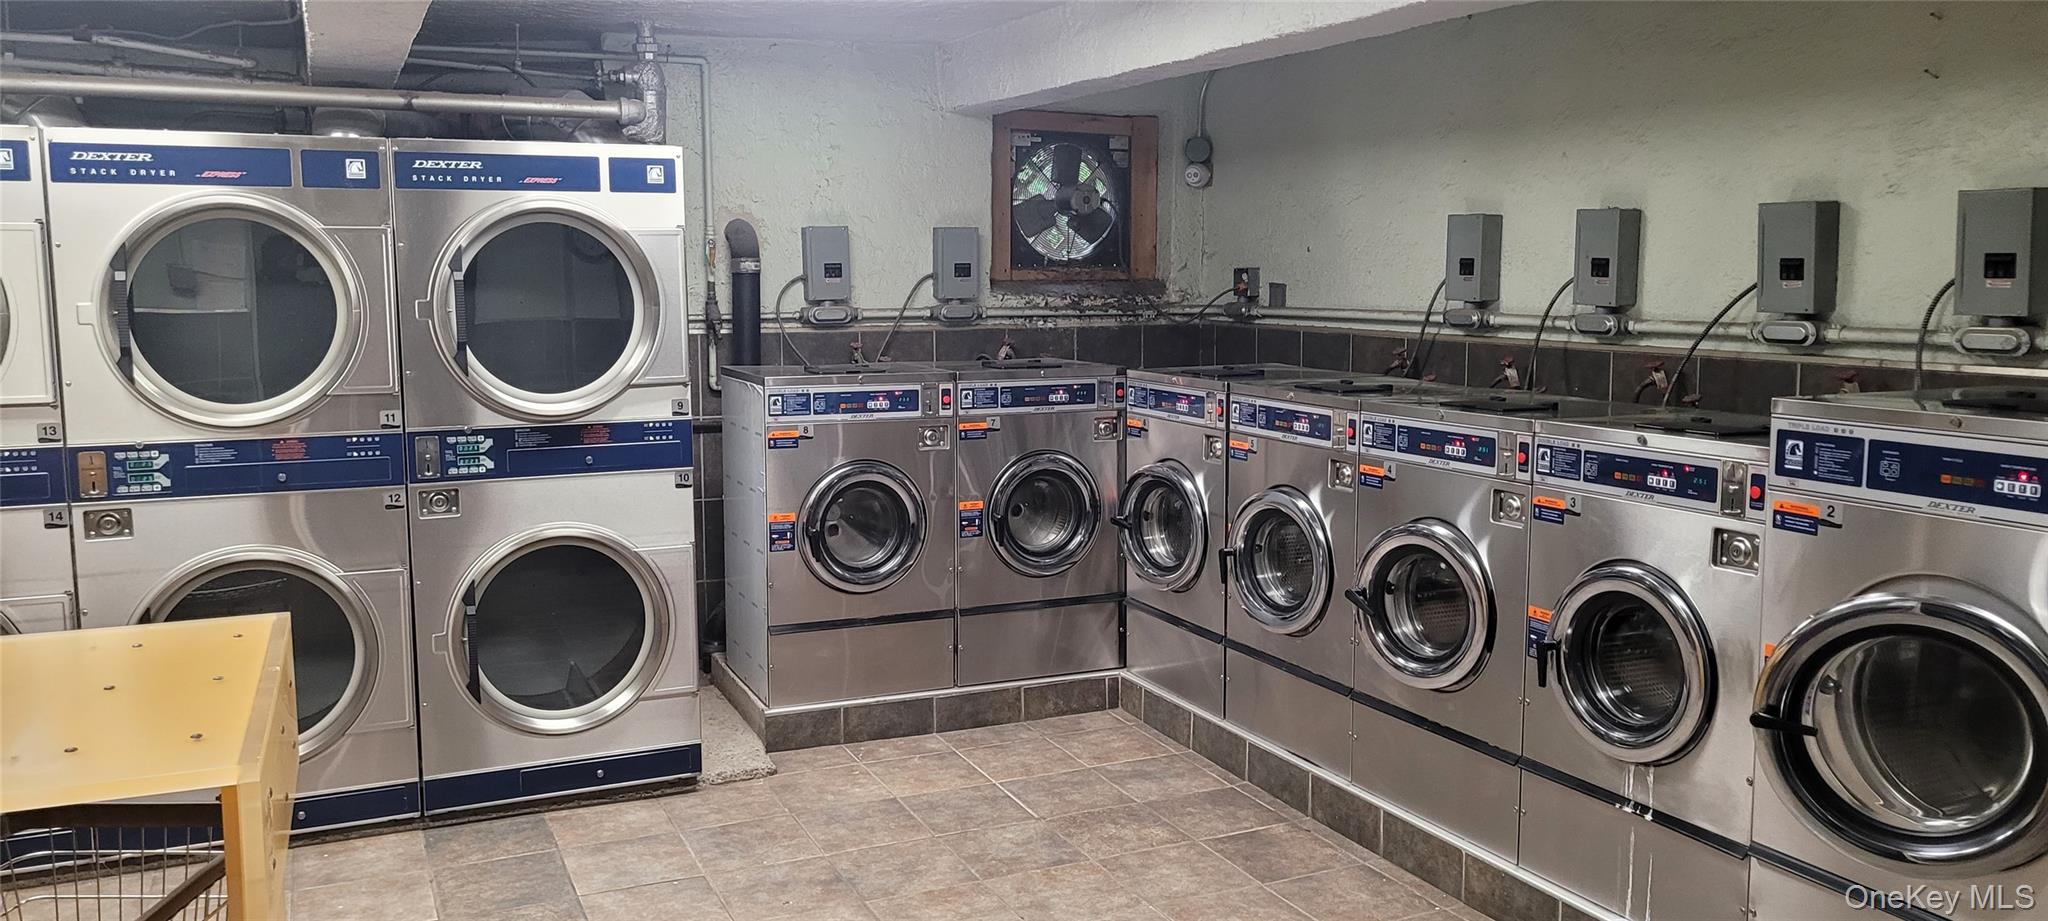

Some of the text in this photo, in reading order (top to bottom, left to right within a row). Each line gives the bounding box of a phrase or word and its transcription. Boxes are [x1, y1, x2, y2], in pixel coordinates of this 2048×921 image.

[70, 151, 154, 162] DEXTER
[412, 159, 483, 169] DEXTER
[69, 167, 176, 177] STACK DRYER
[412, 174, 503, 183] STACK DRYER
[677, 402, 684, 411] 9
[384, 412, 396, 423] 11
[990, 418, 996, 427] 7
[803, 426, 809, 434] 8
[1788, 422, 1810, 430] TRIPLE
[42, 426, 57, 437] 13
[1250, 439, 1255, 448] 5
[1428, 458, 1450, 467] DEXTER
[1387, 465, 1392, 474] 4
[678, 473, 690, 482] 10
[388, 493, 402, 503] 12
[1625, 490, 1655, 501] DEXTER
[1570, 497, 1576, 508] 3
[1927, 501, 1976, 514] DEXTER
[49, 511, 64, 521] 14
[1826, 505, 1836, 518] 2
